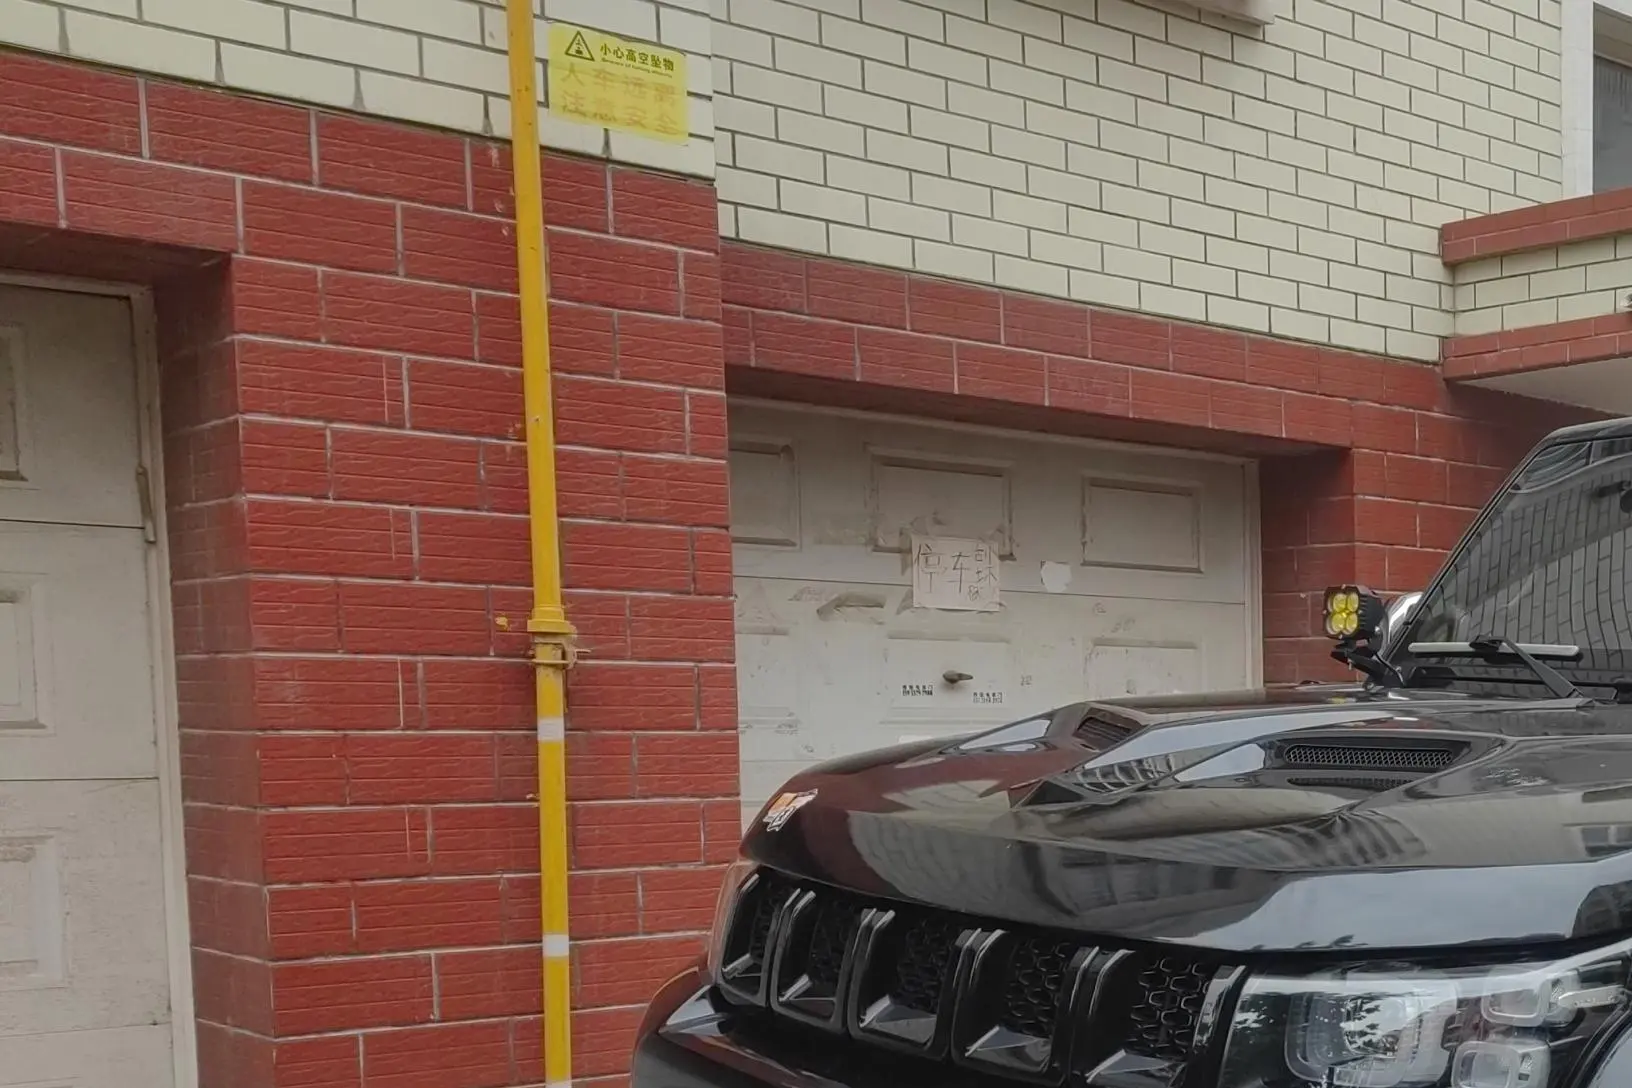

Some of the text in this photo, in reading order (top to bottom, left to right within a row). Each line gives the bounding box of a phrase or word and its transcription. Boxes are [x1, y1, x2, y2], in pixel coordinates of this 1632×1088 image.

[600, 43, 674, 71] 小心高空坠物
